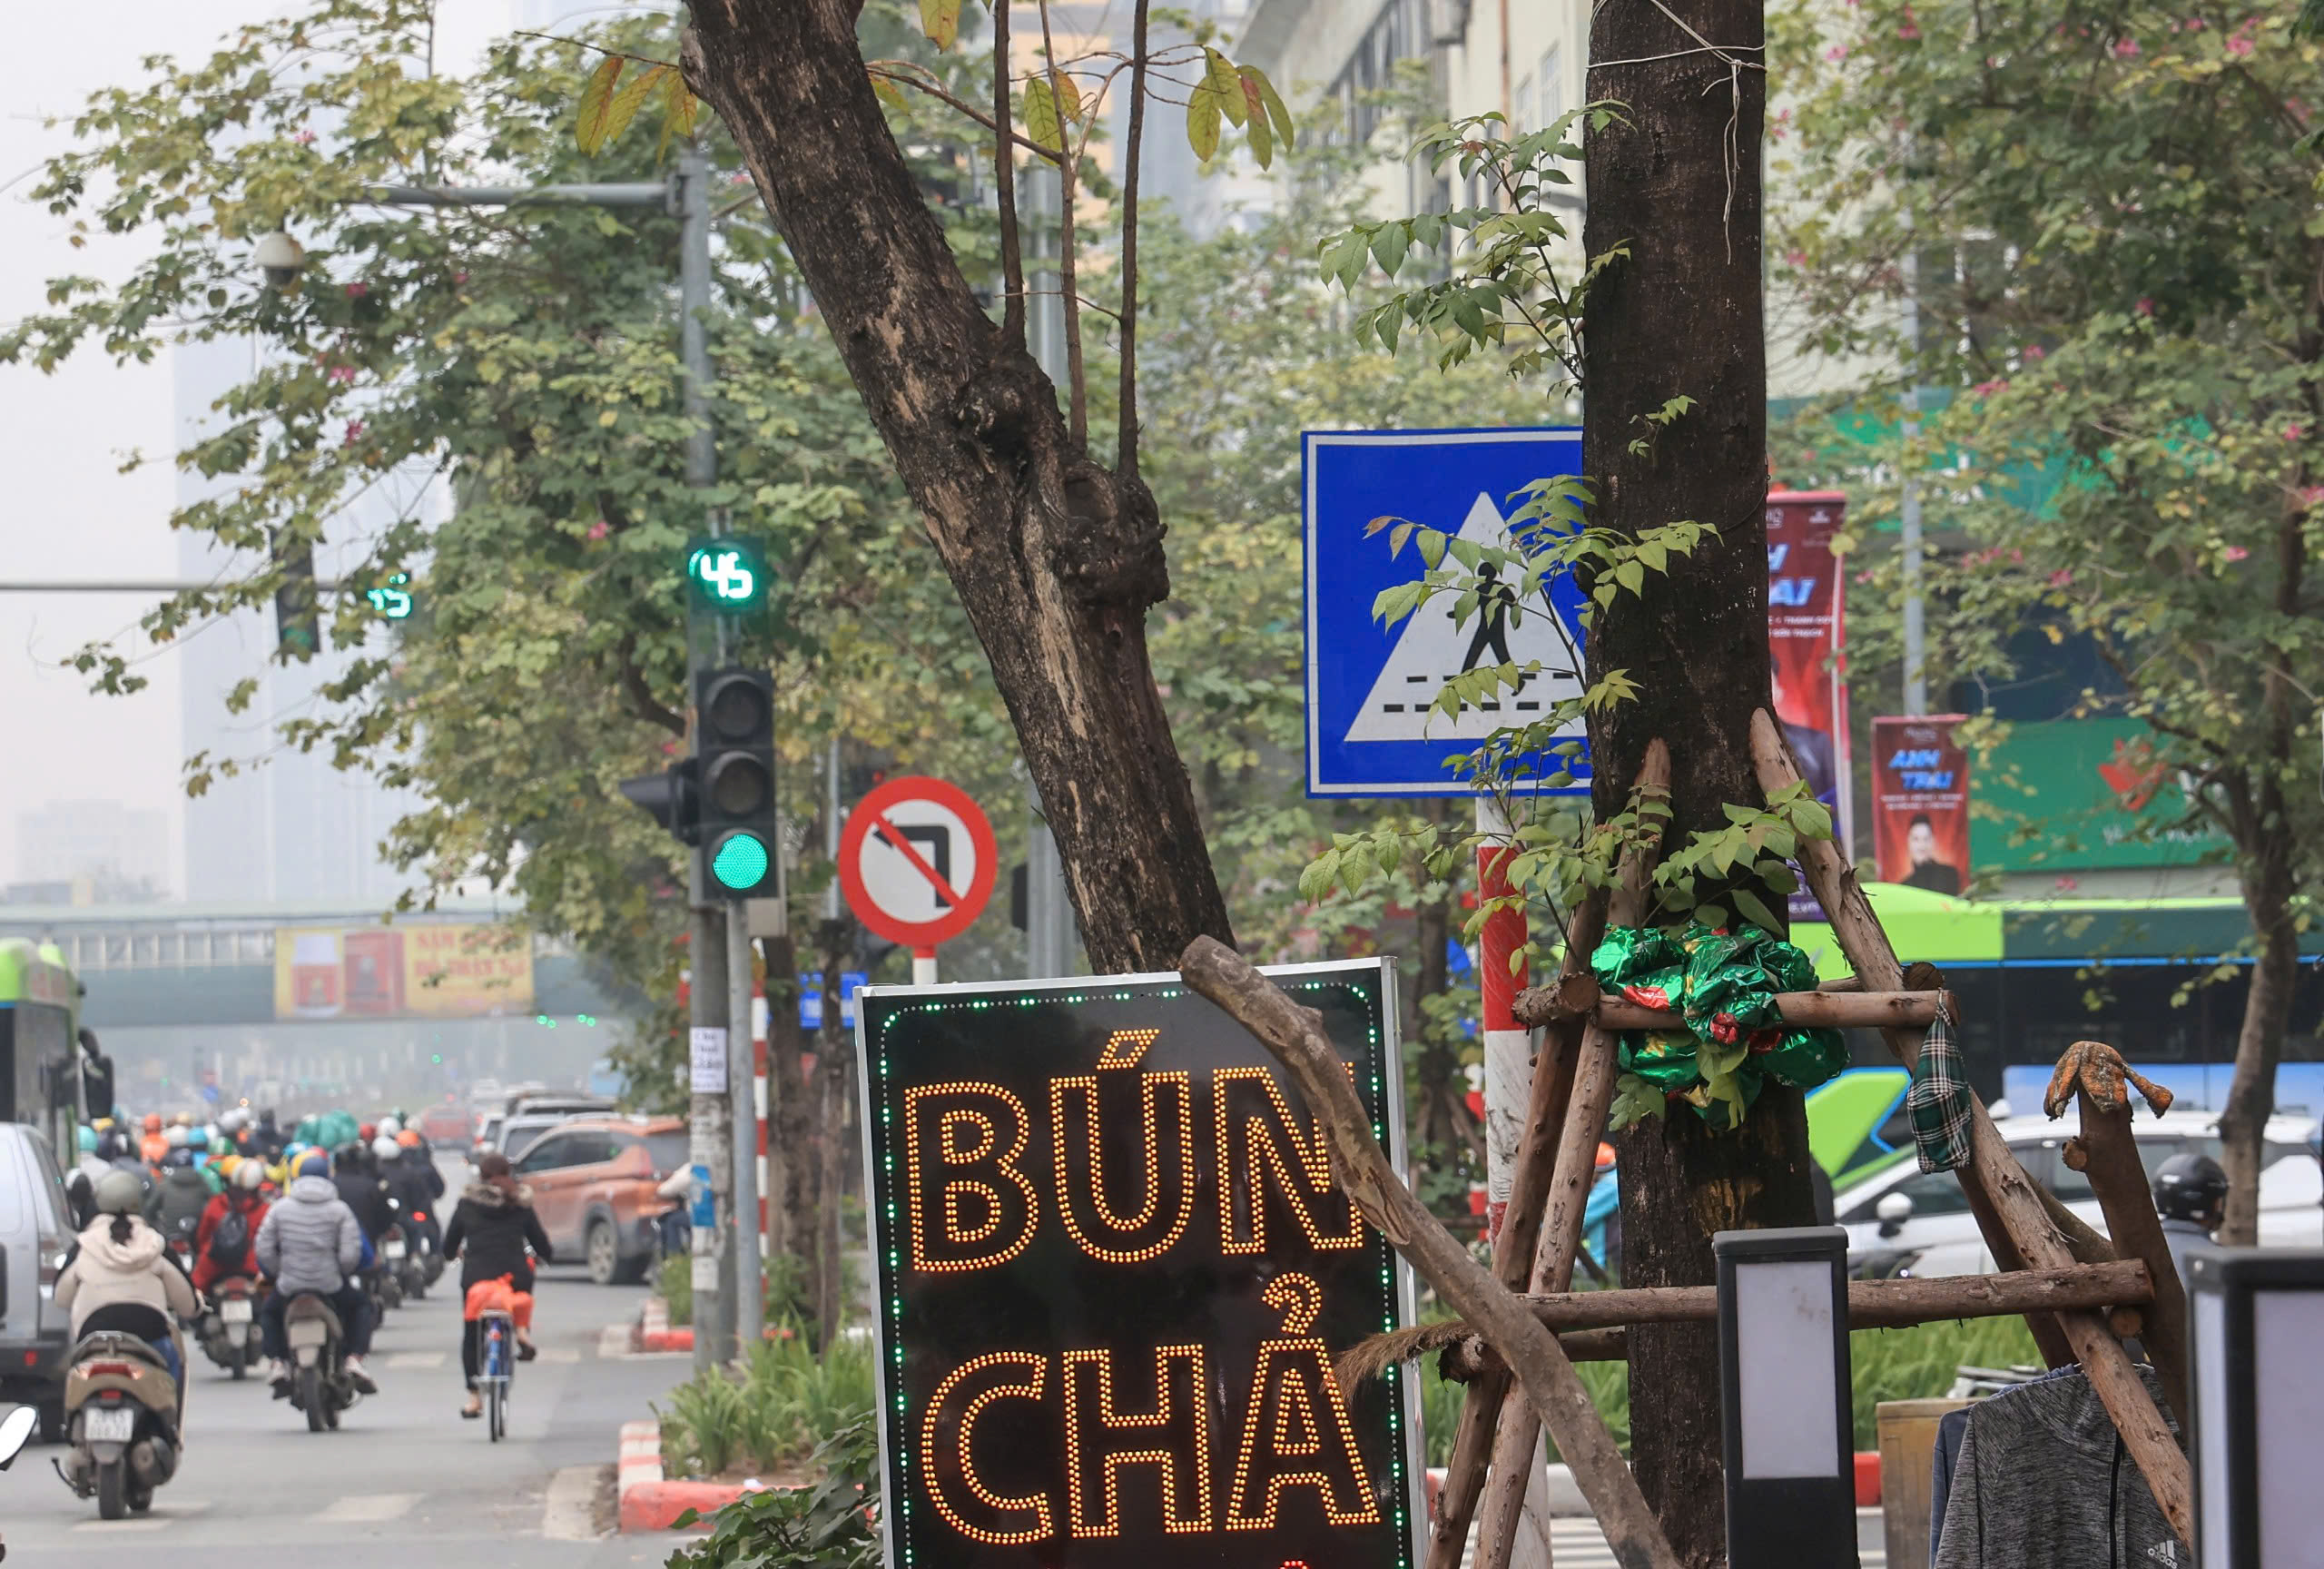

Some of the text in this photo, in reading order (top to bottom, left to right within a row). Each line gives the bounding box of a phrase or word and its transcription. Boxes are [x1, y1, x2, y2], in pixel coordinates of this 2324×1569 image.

[700, 552, 753, 599] 45
[1888, 749, 1941, 768] ANH
[1900, 771, 1954, 790] TRAI
[903, 1029, 1364, 1272] BÚN
[921, 1271, 1381, 1545] CHẢ
